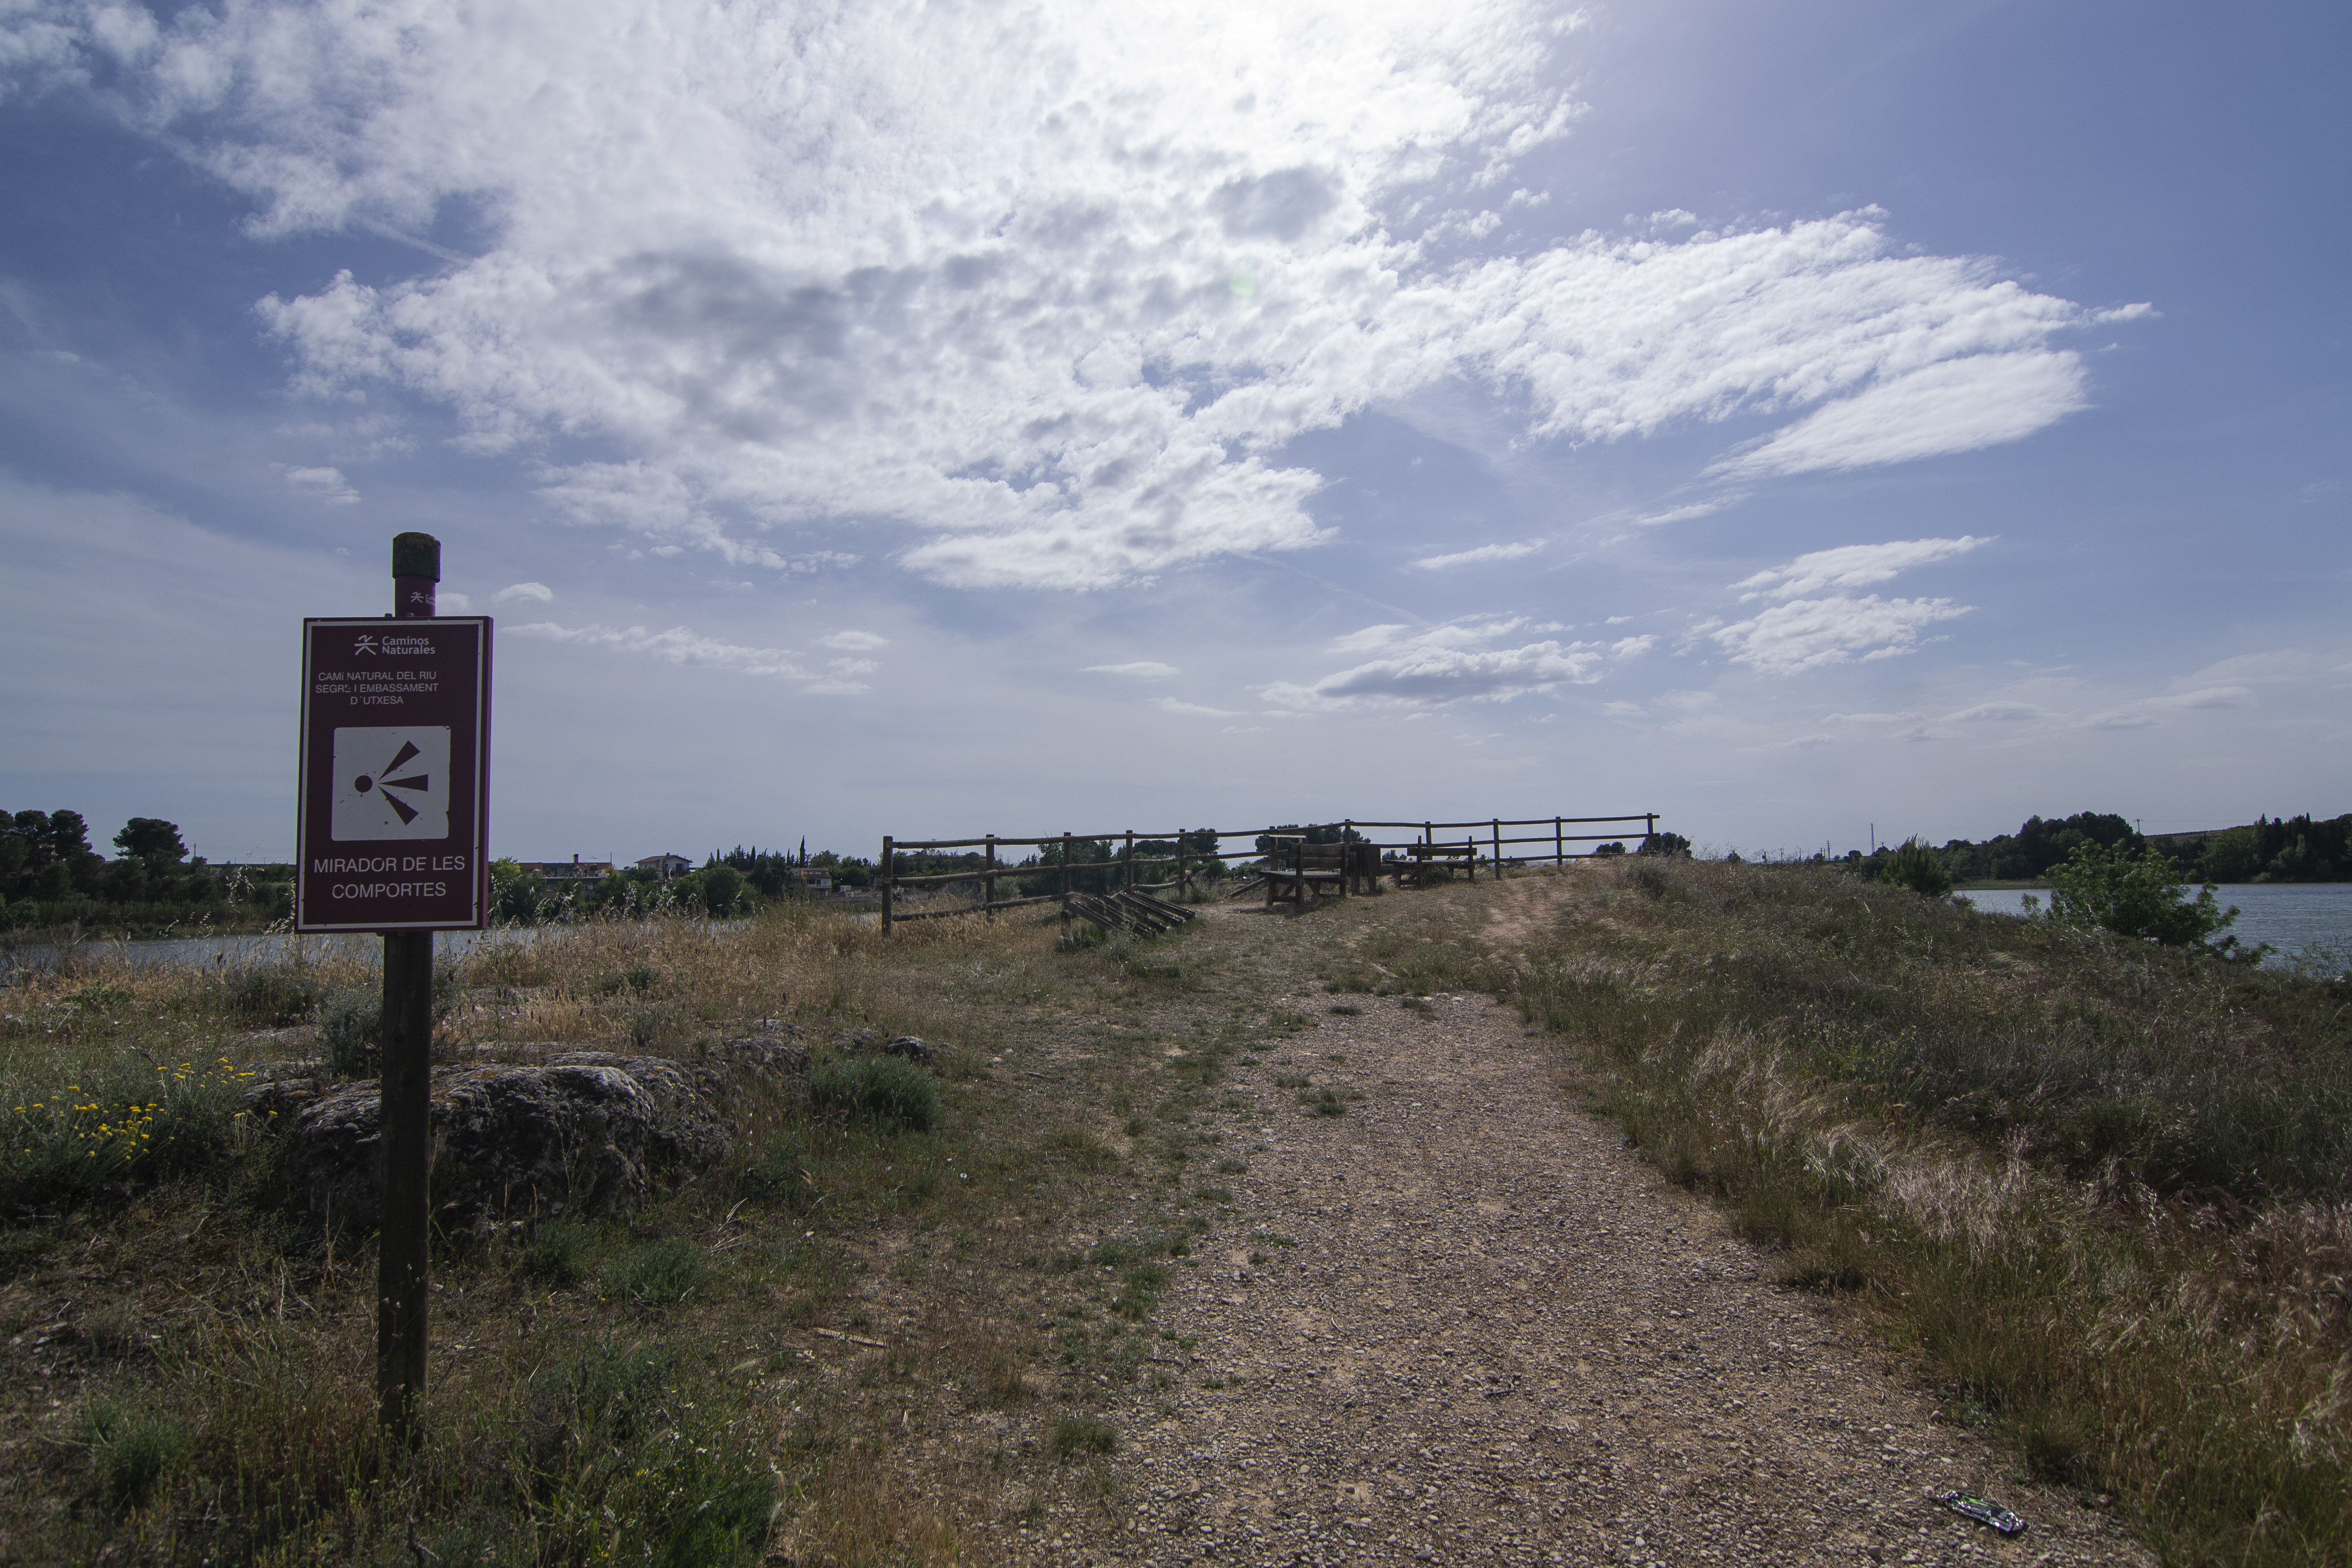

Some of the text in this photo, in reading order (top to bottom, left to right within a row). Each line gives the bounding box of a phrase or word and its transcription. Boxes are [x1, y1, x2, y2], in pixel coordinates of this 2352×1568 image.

[382, 636, 429, 646] Caminos
[382, 645, 435, 655] Naturales
[347, 672, 394, 680] NATURAL
[397, 671, 416, 679] DEL
[419, 671, 436, 679] RIU
[354, 684, 357, 693] I
[360, 683, 439, 692] EMBASSAMENT
[314, 856, 465, 873] MIRADOR DE LES
[332, 883, 446, 898] COMPORTES
